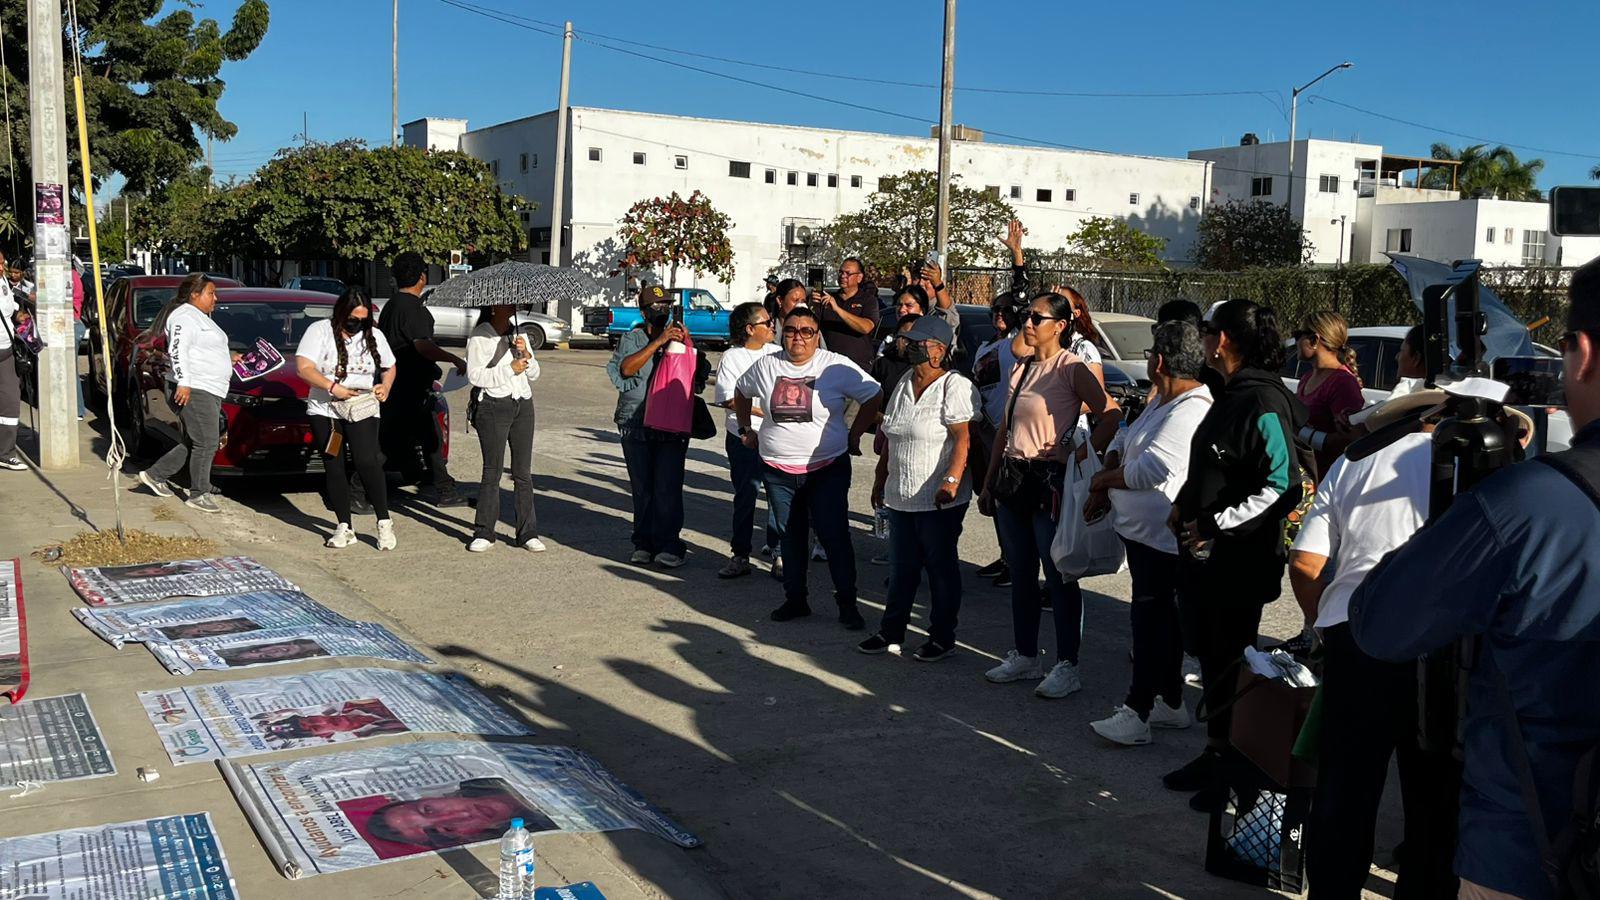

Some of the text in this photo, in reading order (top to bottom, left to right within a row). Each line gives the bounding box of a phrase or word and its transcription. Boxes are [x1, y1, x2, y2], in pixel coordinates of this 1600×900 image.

[174, 324, 182, 336] TU
[325, 812, 345, 828] ABEL
[336, 828, 358, 842] LUIS
